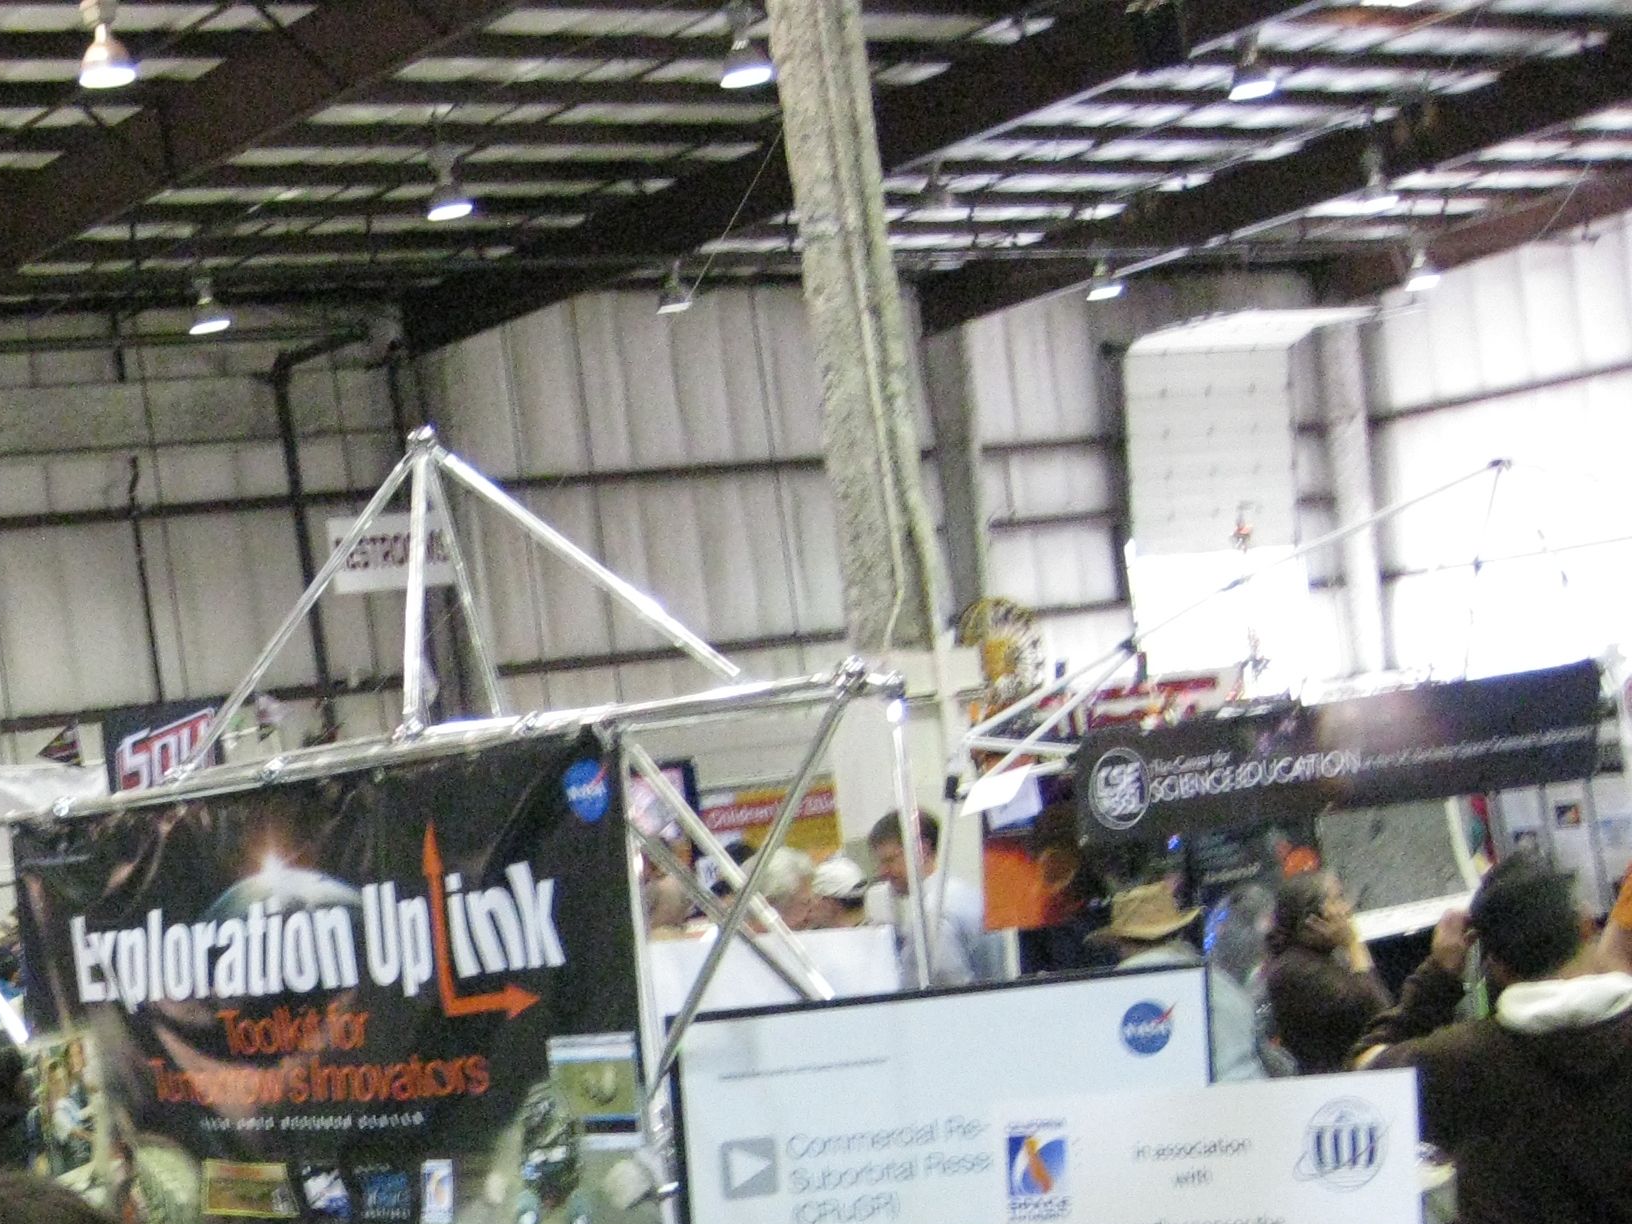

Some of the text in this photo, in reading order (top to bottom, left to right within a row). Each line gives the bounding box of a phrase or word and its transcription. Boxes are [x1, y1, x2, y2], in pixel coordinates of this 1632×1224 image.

[1149, 750, 1362, 803] SCIENCE EDUCATION
[70, 894, 359, 1014] Exploration
[217, 998, 369, 1056] Toolkit for
[310, 1053, 491, 1102] Innovators
